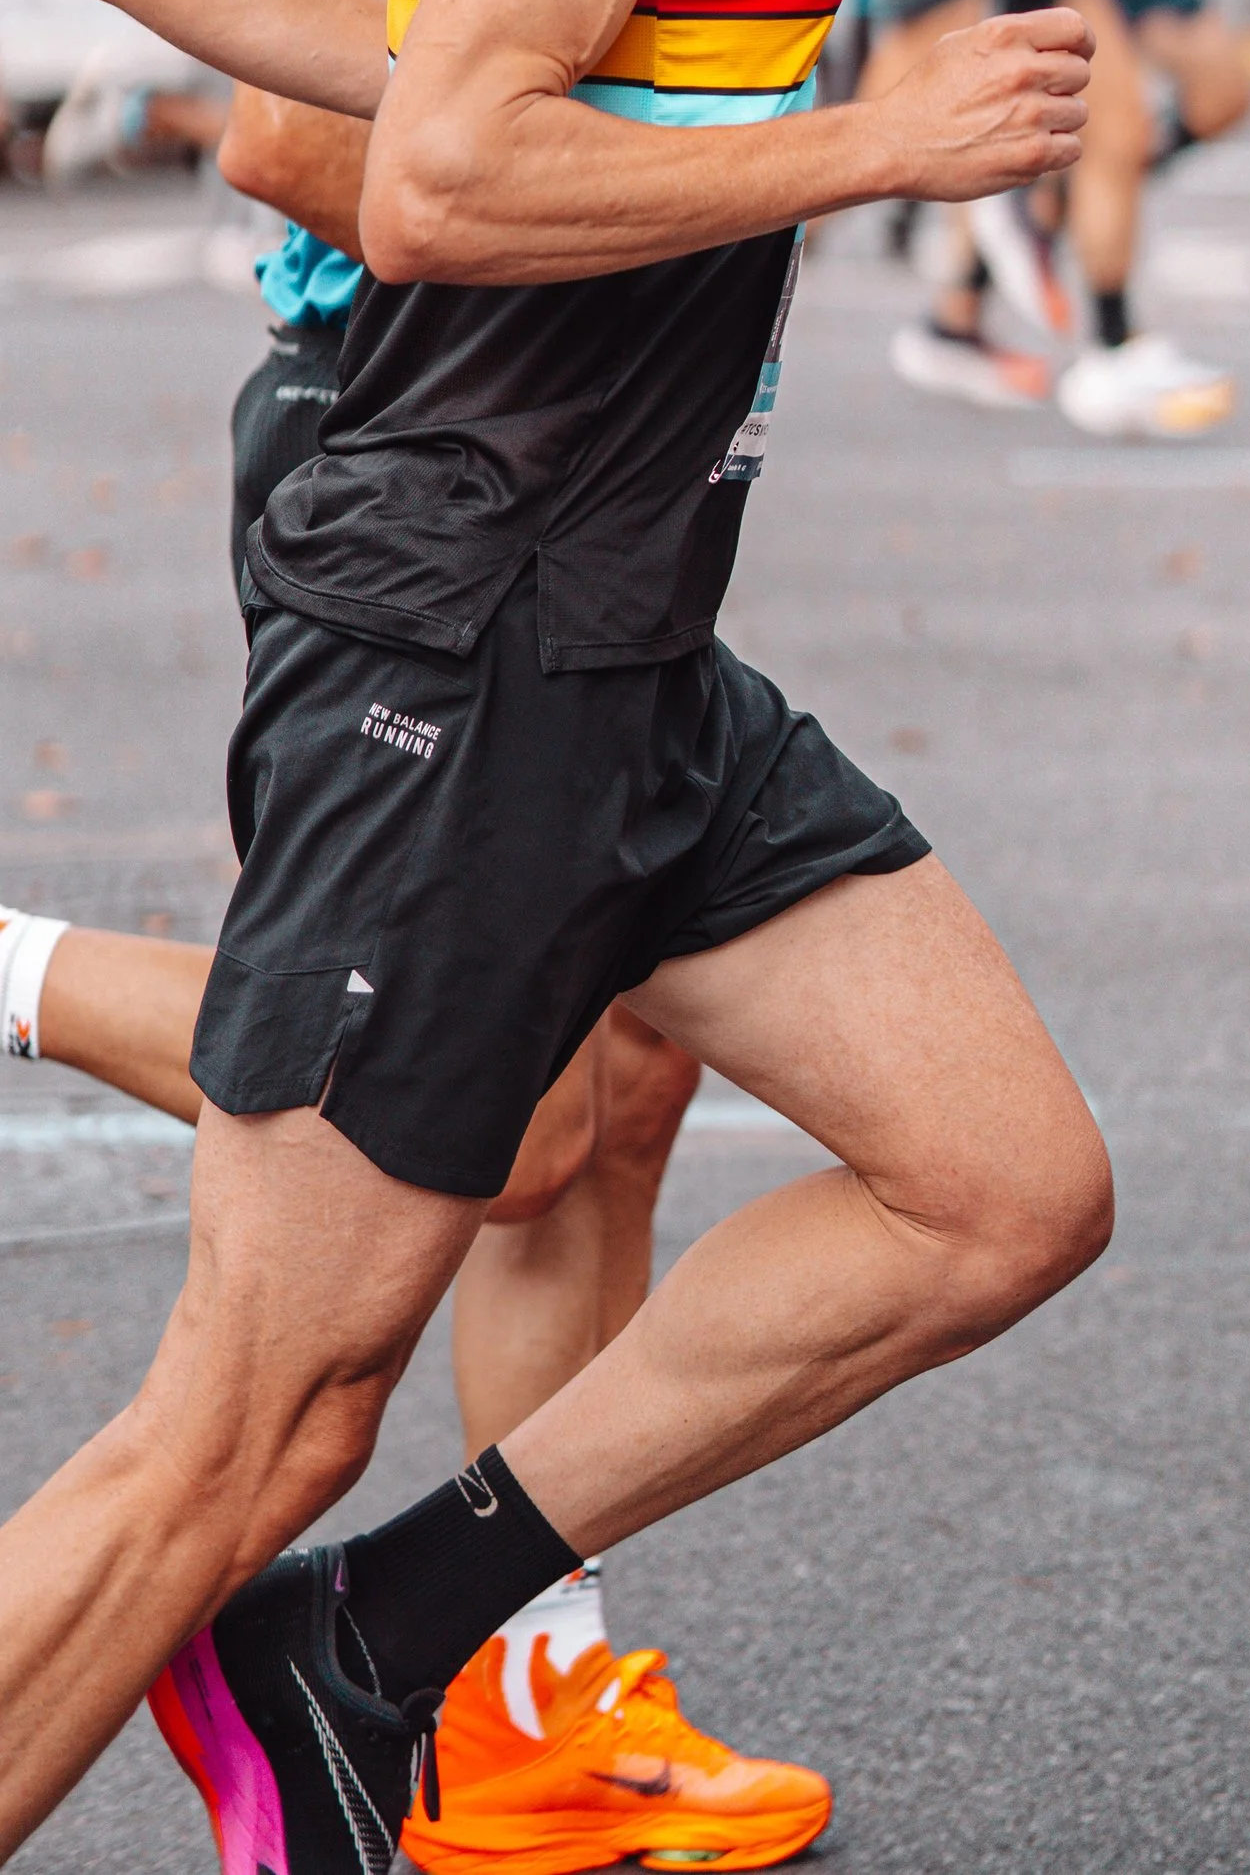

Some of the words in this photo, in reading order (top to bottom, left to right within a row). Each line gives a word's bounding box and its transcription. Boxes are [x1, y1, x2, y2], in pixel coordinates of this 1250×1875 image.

[360, 716, 435, 760] RUNNING
[368, 702, 391, 721] NEW
[393, 713, 442, 741] BALANCE
